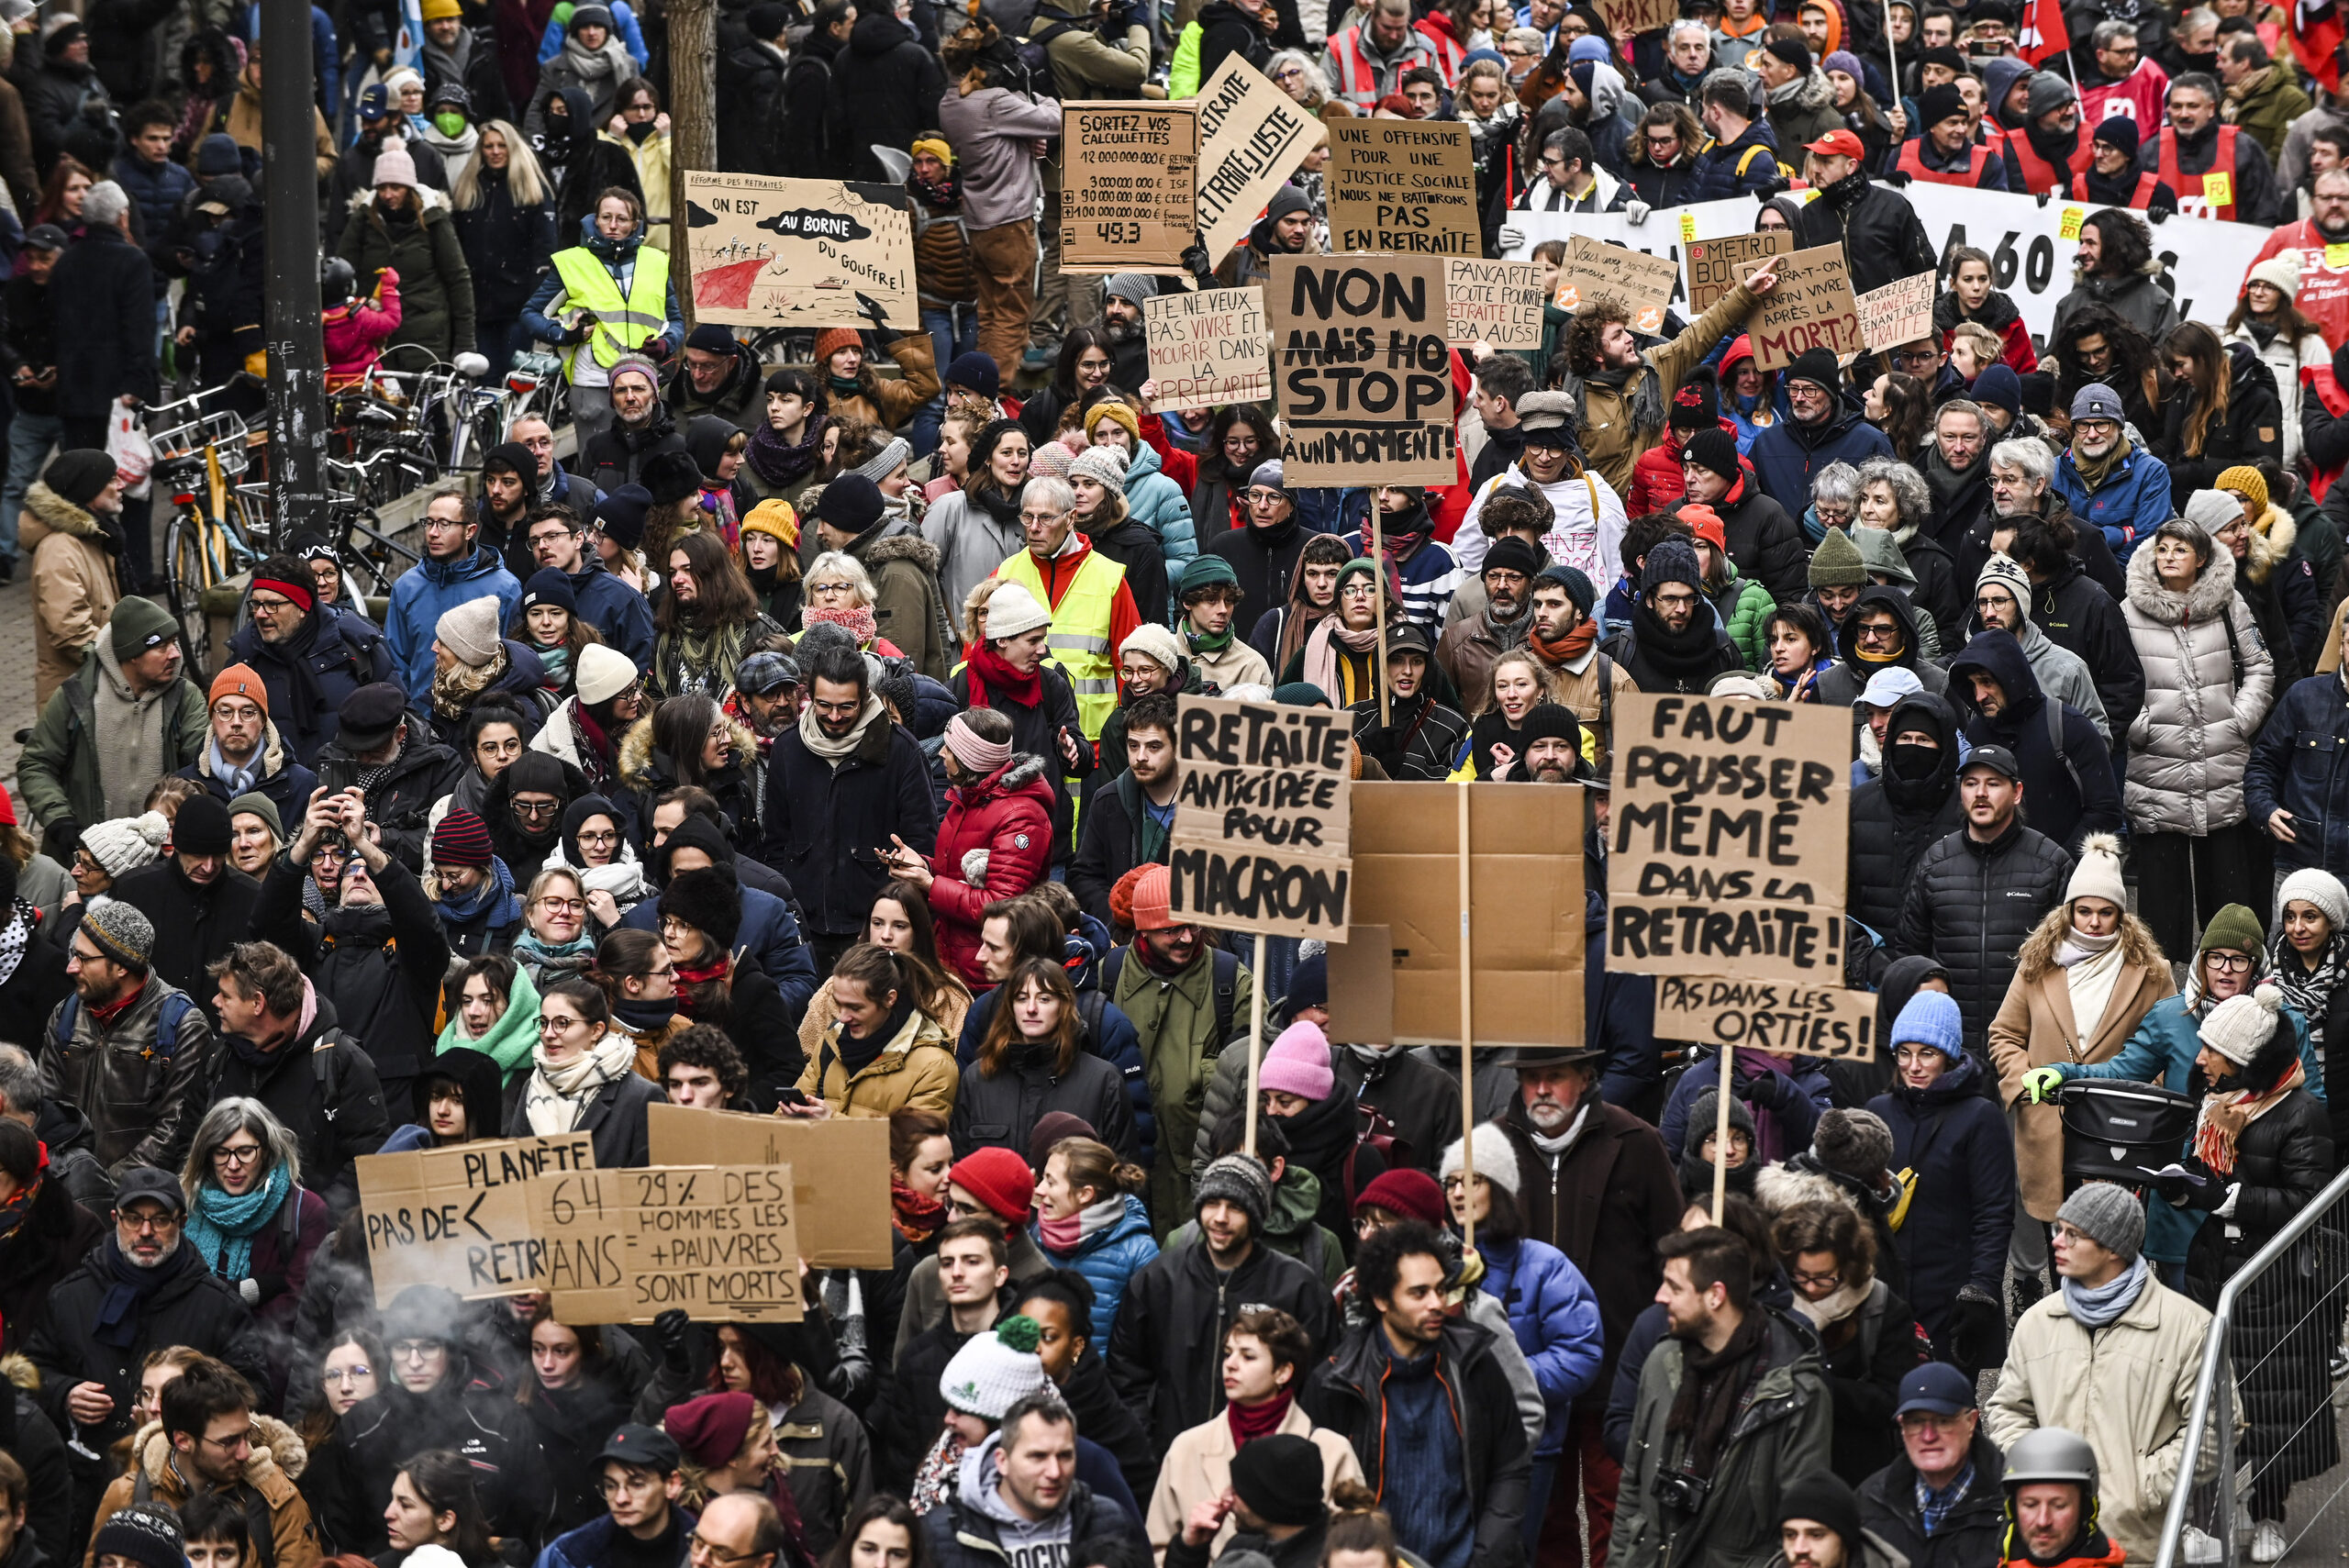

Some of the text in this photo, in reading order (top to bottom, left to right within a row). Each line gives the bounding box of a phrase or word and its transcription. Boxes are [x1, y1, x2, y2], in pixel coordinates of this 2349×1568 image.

[1080, 115, 1172, 133] SORTEZ VOS
[1339, 129, 1372, 144] UNE
[1082, 132, 1170, 145] CALCULLETTES
[1243, 105, 1298, 174] JUSTE
[1080, 150, 1095, 164] 12
[1351, 149, 1444, 166] POUR UNE
[690, 174, 722, 185] RÉFORME
[727, 178, 740, 186] DES
[1090, 176, 1097, 188] 3
[1170, 179, 1189, 190] ISF
[712, 197, 759, 216] ON EST
[1081, 189, 1097, 203] 90
[1164, 194, 1189, 204] CICE
[1340, 189, 1372, 202] NOUS
[1378, 191, 1396, 203] NE
[1402, 191, 1468, 206] BATTRONS
[1074, 206, 1095, 218] 100
[1377, 206, 1431, 228] PAS
[778, 215, 851, 237] AU BORNE
[1097, 222, 1141, 244] 49.3
[1343, 229, 1373, 250] EN
[818, 240, 837, 258] DU
[1570, 235, 1598, 263] Vous
[1708, 236, 1776, 261] METRO
[1451, 261, 1542, 286] PANCARTE
[1991, 230, 2054, 295] 60
[1291, 265, 1426, 322] NON
[1447, 284, 1494, 302] TOUTE
[1651, 286, 1666, 297] ma
[1762, 277, 1845, 310] ENFIN VIVRE
[1921, 284, 1932, 299] ET
[1147, 292, 1252, 319] JE NE VEUX
[1513, 306, 1537, 325] LE
[1765, 300, 1834, 328] APRÈS LA
[1860, 308, 1900, 332] ENANT
[1905, 298, 1932, 315] NOTRE
[1150, 321, 1186, 343] PAS
[1242, 312, 1260, 334] ET
[1447, 320, 1479, 339] ERA
[1759, 313, 1858, 364] MORT?
[1864, 312, 1931, 349] TRAITE
[1219, 337, 1265, 360] DANS
[1192, 361, 1216, 379] LA
[1287, 367, 1446, 419] STOP
[1300, 438, 1324, 464] UN
[1325, 424, 1455, 463] MOMENT!
[298, 545, 340, 564] NASA
[1653, 697, 1793, 746] FAUT
[1625, 745, 1834, 805] POUSSER
[1223, 807, 1323, 847] POUR
[1616, 787, 1803, 866] MÉMÉ
[1171, 849, 1347, 927] MACRON
[1638, 862, 1815, 905] DANS LA
[1661, 976, 1834, 1013] PAS DANS LES
[463, 1139, 593, 1188] PLANÈTE
[552, 1175, 603, 1225] 64
[638, 1172, 668, 1207] 29
[724, 1171, 784, 1205] DES
[368, 1205, 459, 1250] PAS DE
[640, 1204, 789, 1232] HOMMES LES
[467, 1237, 549, 1287] RETR
[551, 1234, 622, 1289] ANS
[635, 1269, 796, 1304] SONT MORTS
